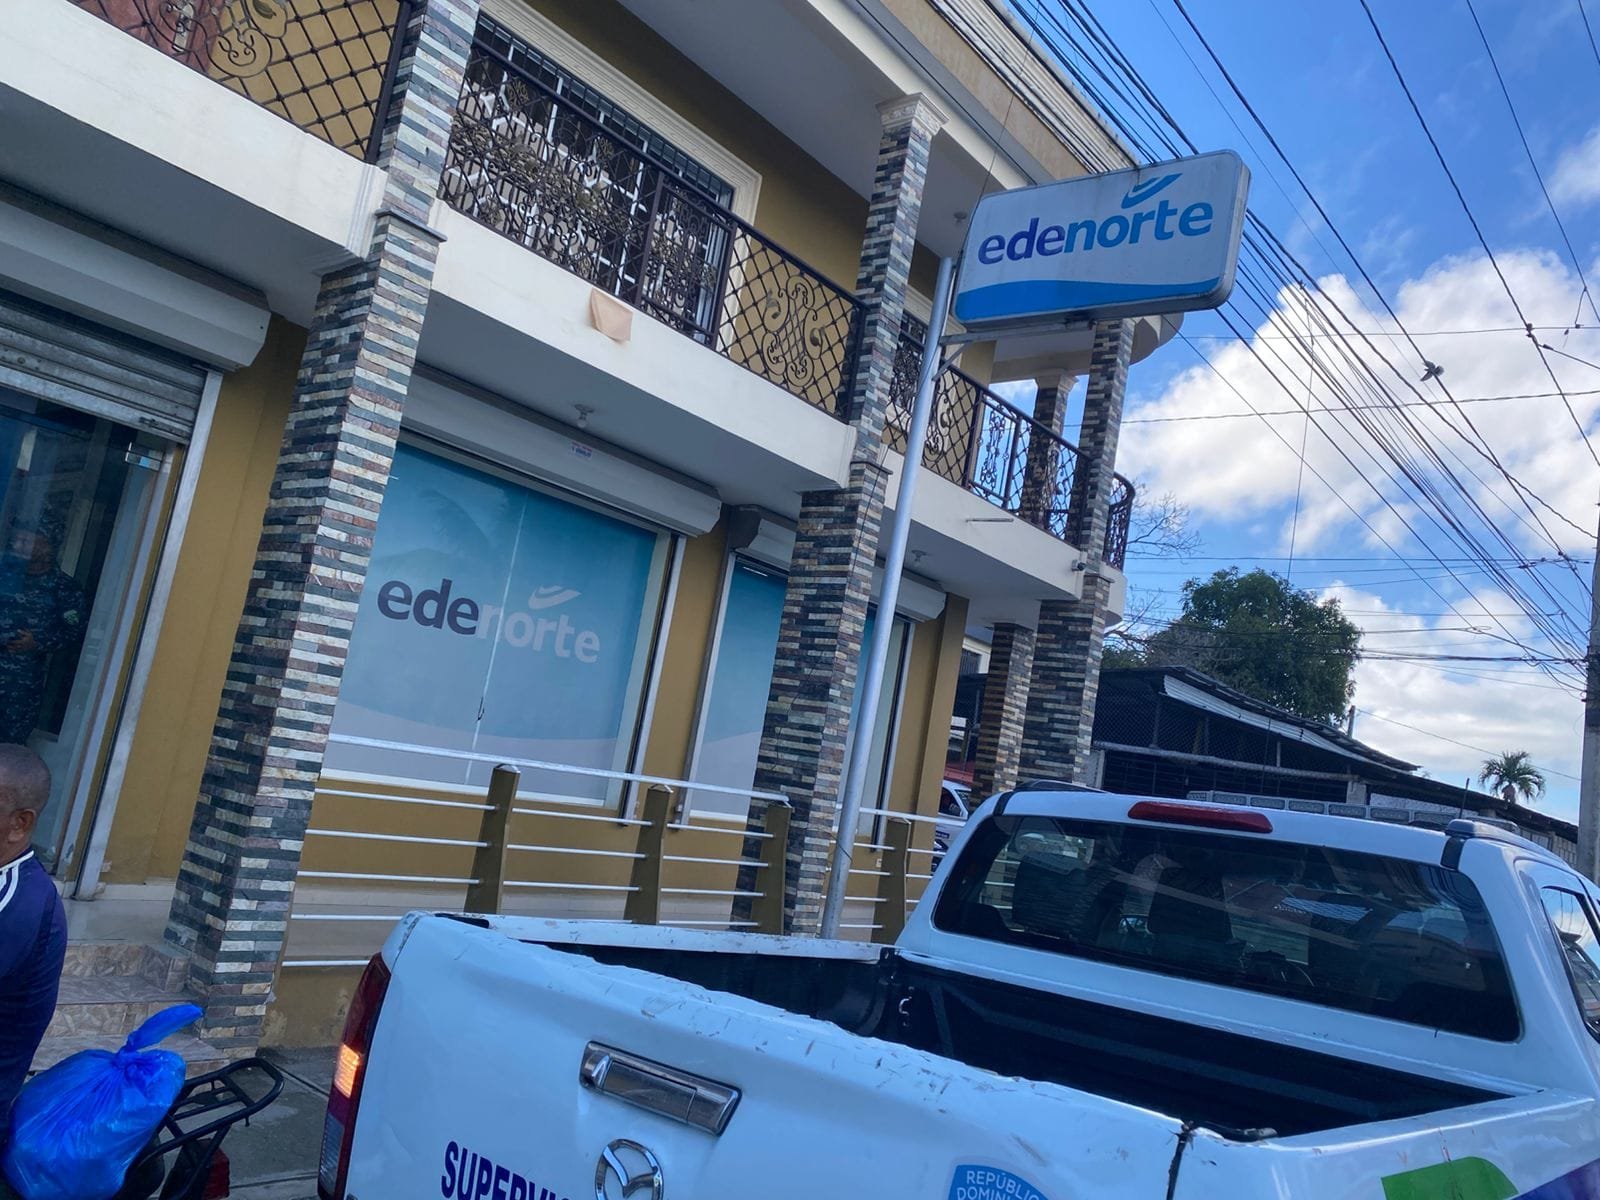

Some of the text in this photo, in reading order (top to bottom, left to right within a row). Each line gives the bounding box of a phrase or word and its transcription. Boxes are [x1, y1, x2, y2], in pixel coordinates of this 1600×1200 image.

[977, 199, 1214, 265] edenorte
[377, 578, 601, 664] edenorte
[441, 1140, 570, 1200] SUPER
